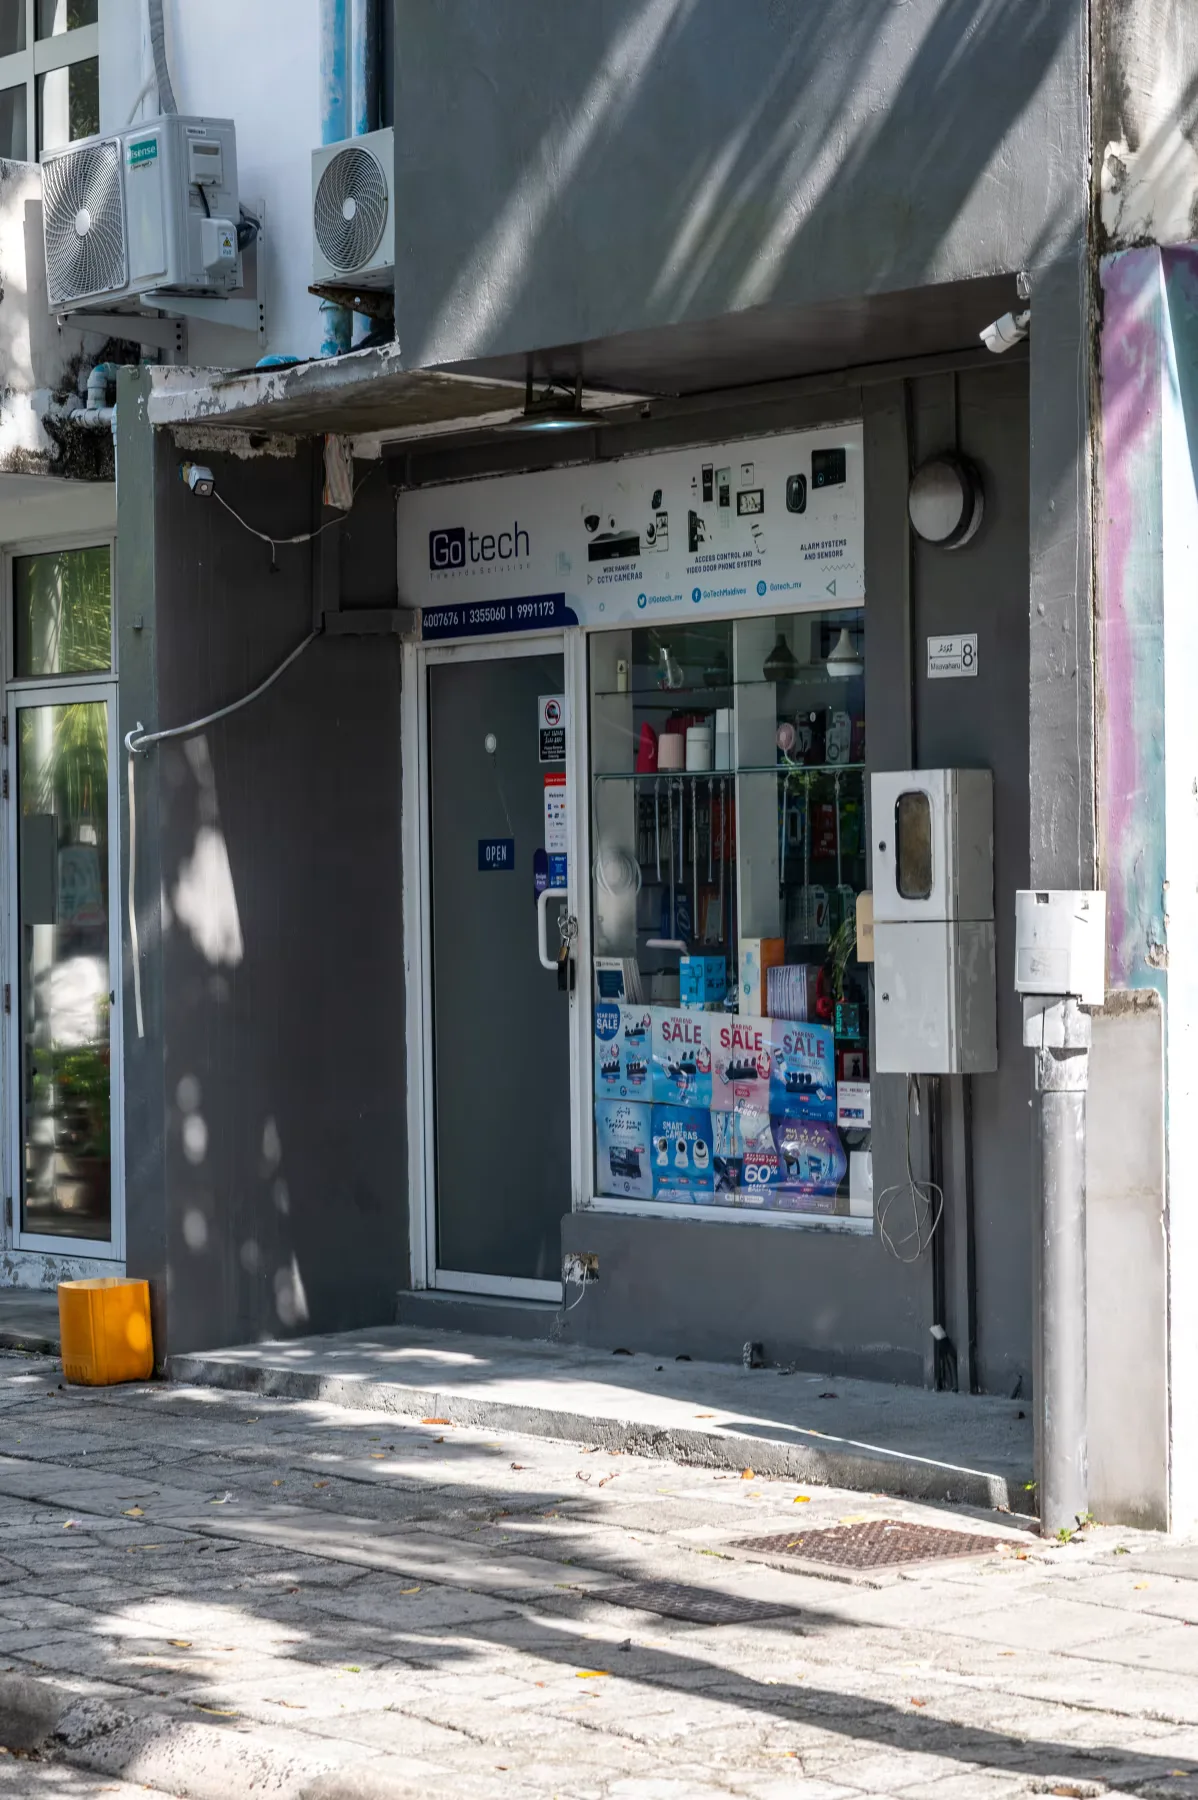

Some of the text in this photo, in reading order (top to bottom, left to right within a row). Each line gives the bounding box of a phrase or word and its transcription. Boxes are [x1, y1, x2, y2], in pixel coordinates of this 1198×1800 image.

[800, 539, 847, 551] ALARM SYSTEMS
[695, 551, 753, 563] ACCESS CONTROL AND
[804, 550, 843, 561] AND SENSORS
[603, 565, 614, 573] WIDE
[615, 564, 630, 573] RANGE
[686, 559, 762, 574] VIDEO DOOR PHONE SYSTEMS
[597, 572, 643, 584] CCTV CAMERAS
[423, 601, 555, 628] 4007676 3355060 9991173
[962, 643, 973, 667] 8
[485, 845, 507, 861] OPEN
[596, 1019, 618, 1029] SALE
[662, 1021, 702, 1044] SALE
[720, 1028, 762, 1051] SALE
[782, 1034, 825, 1058] SALE
[662, 1121, 683, 1130] SMART
[665, 1130, 698, 1140] CAMERAS
[744, 1163, 778, 1184] 60%
